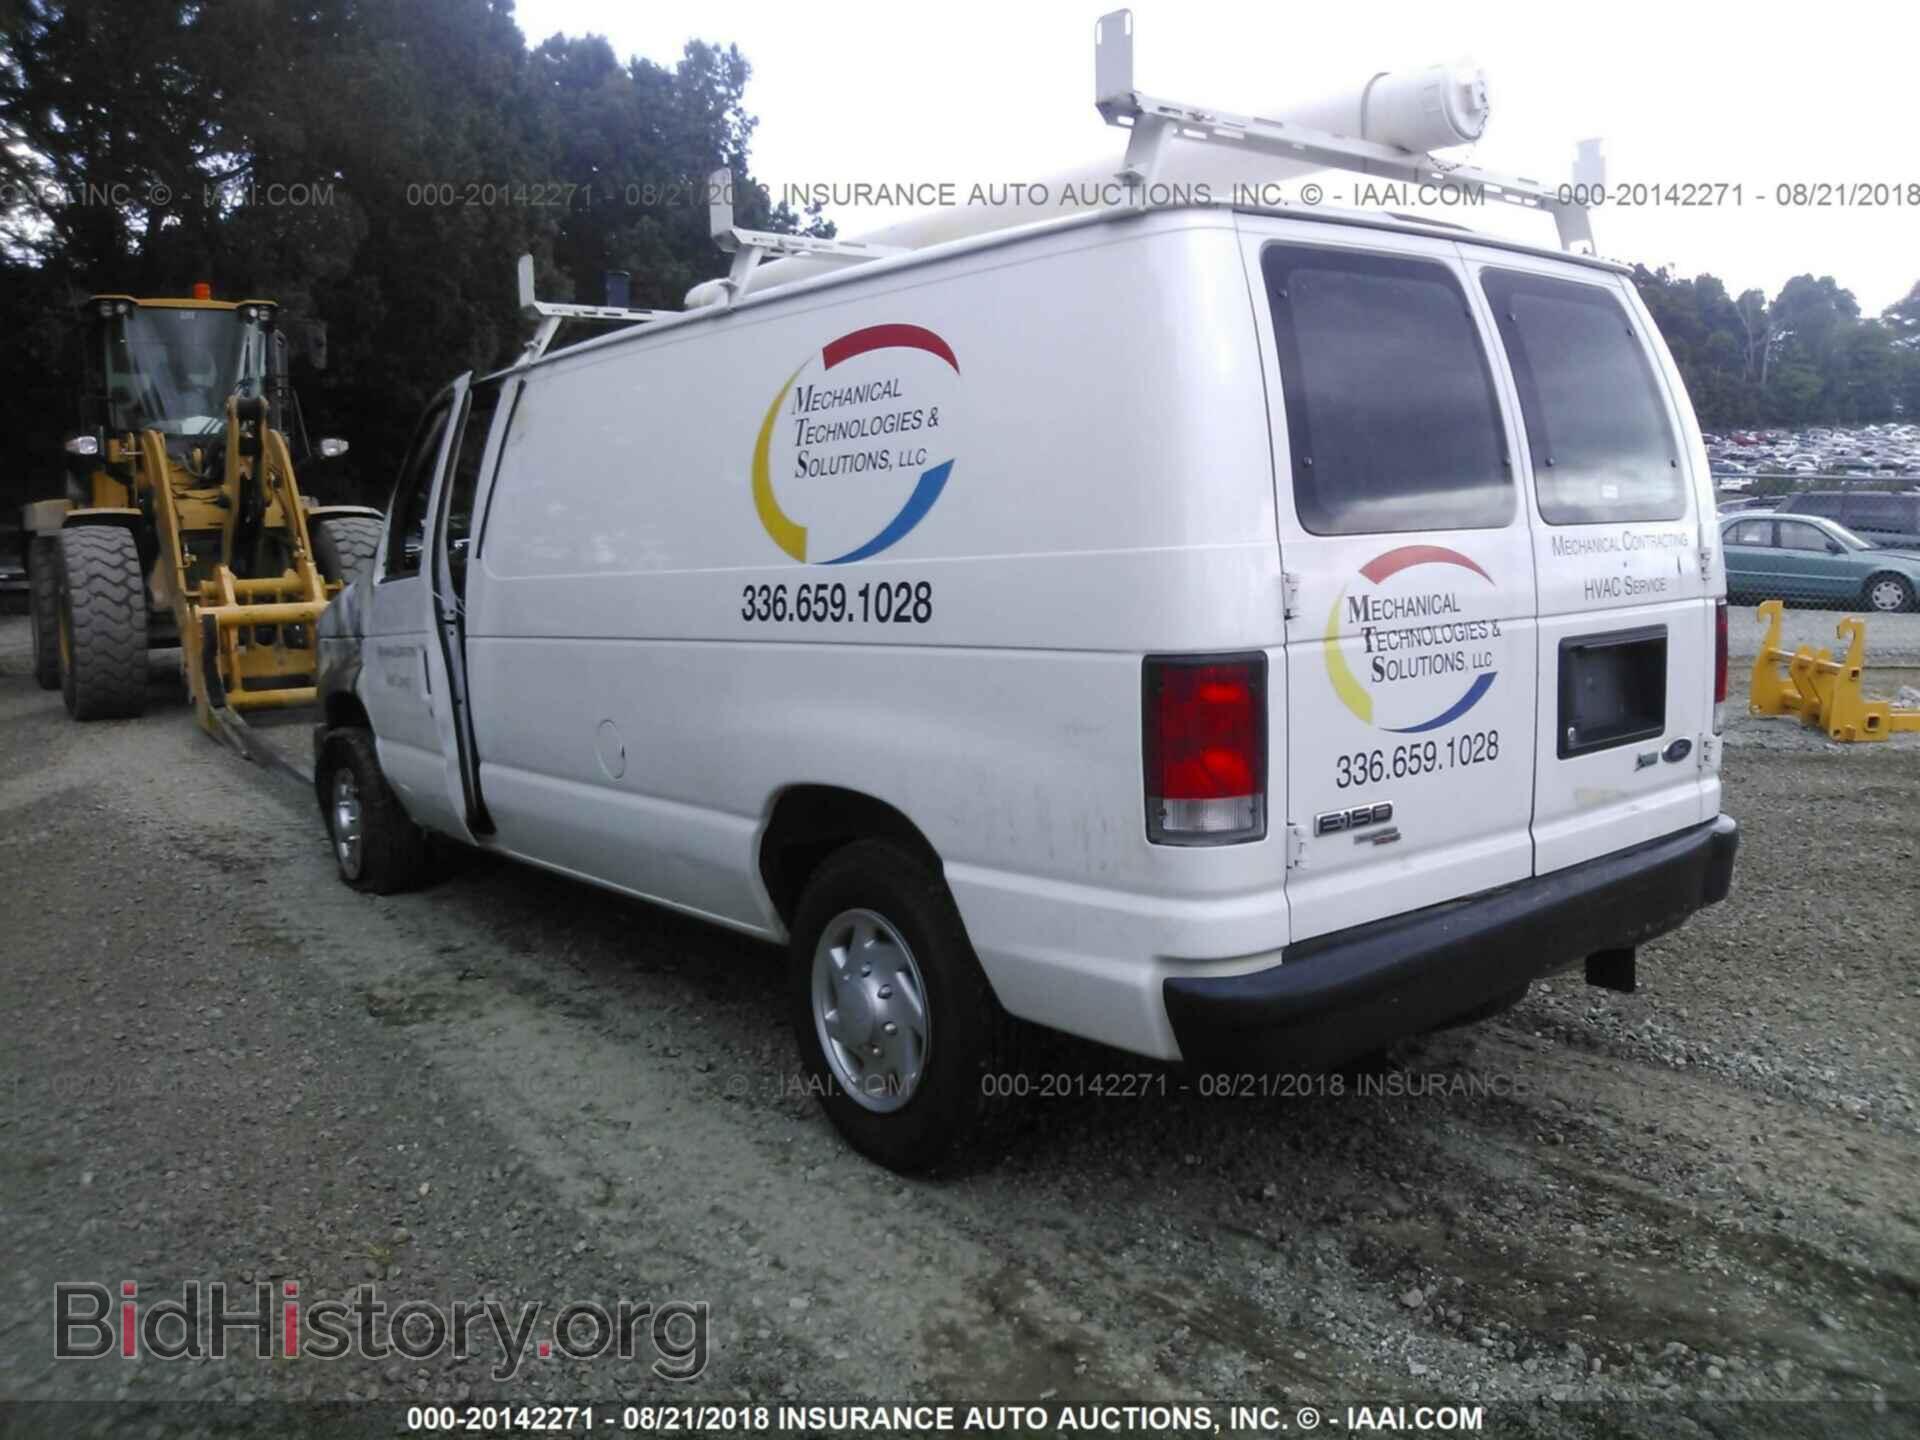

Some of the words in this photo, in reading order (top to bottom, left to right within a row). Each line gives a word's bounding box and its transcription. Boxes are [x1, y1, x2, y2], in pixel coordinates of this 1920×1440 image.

[927, 406, 939, 428] &
[899, 448, 927, 467] LLC
[1585, 576, 1621, 600] HVAC
[742, 580, 933, 624] 336.659.1028
[1473, 651, 1492, 668] LLC
[1336, 730, 1499, 789] 336.659.1028
